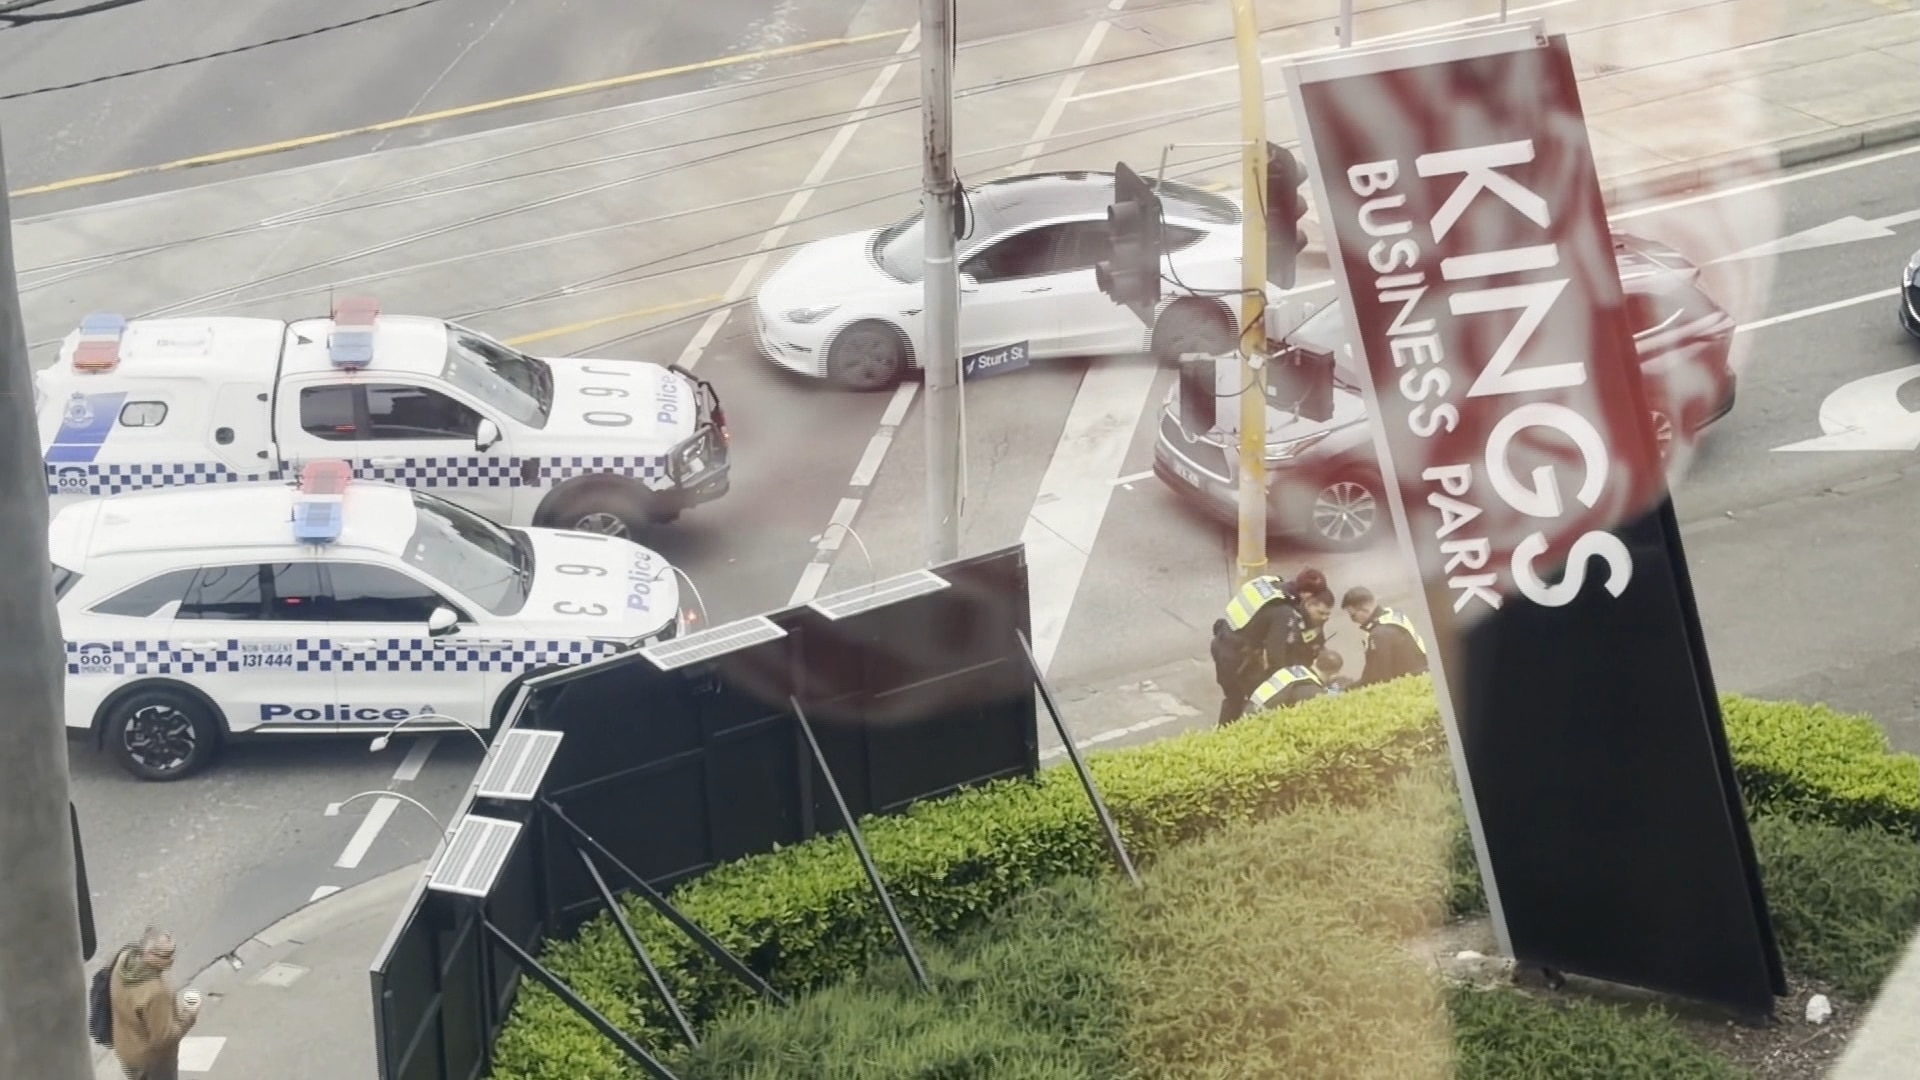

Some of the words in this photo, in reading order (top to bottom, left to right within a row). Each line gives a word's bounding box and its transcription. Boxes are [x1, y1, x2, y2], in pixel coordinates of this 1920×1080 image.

[978, 351, 1008, 369] Sturt
[1011, 346, 1024, 360] St
[1415, 139, 1633, 607] KINGS
[656, 375, 678, 425] Police
[1347, 159, 1459, 437] BUSINESS
[1422, 464, 1502, 613] PARK
[627, 551, 652, 613] Police
[260, 704, 410, 721] Police
